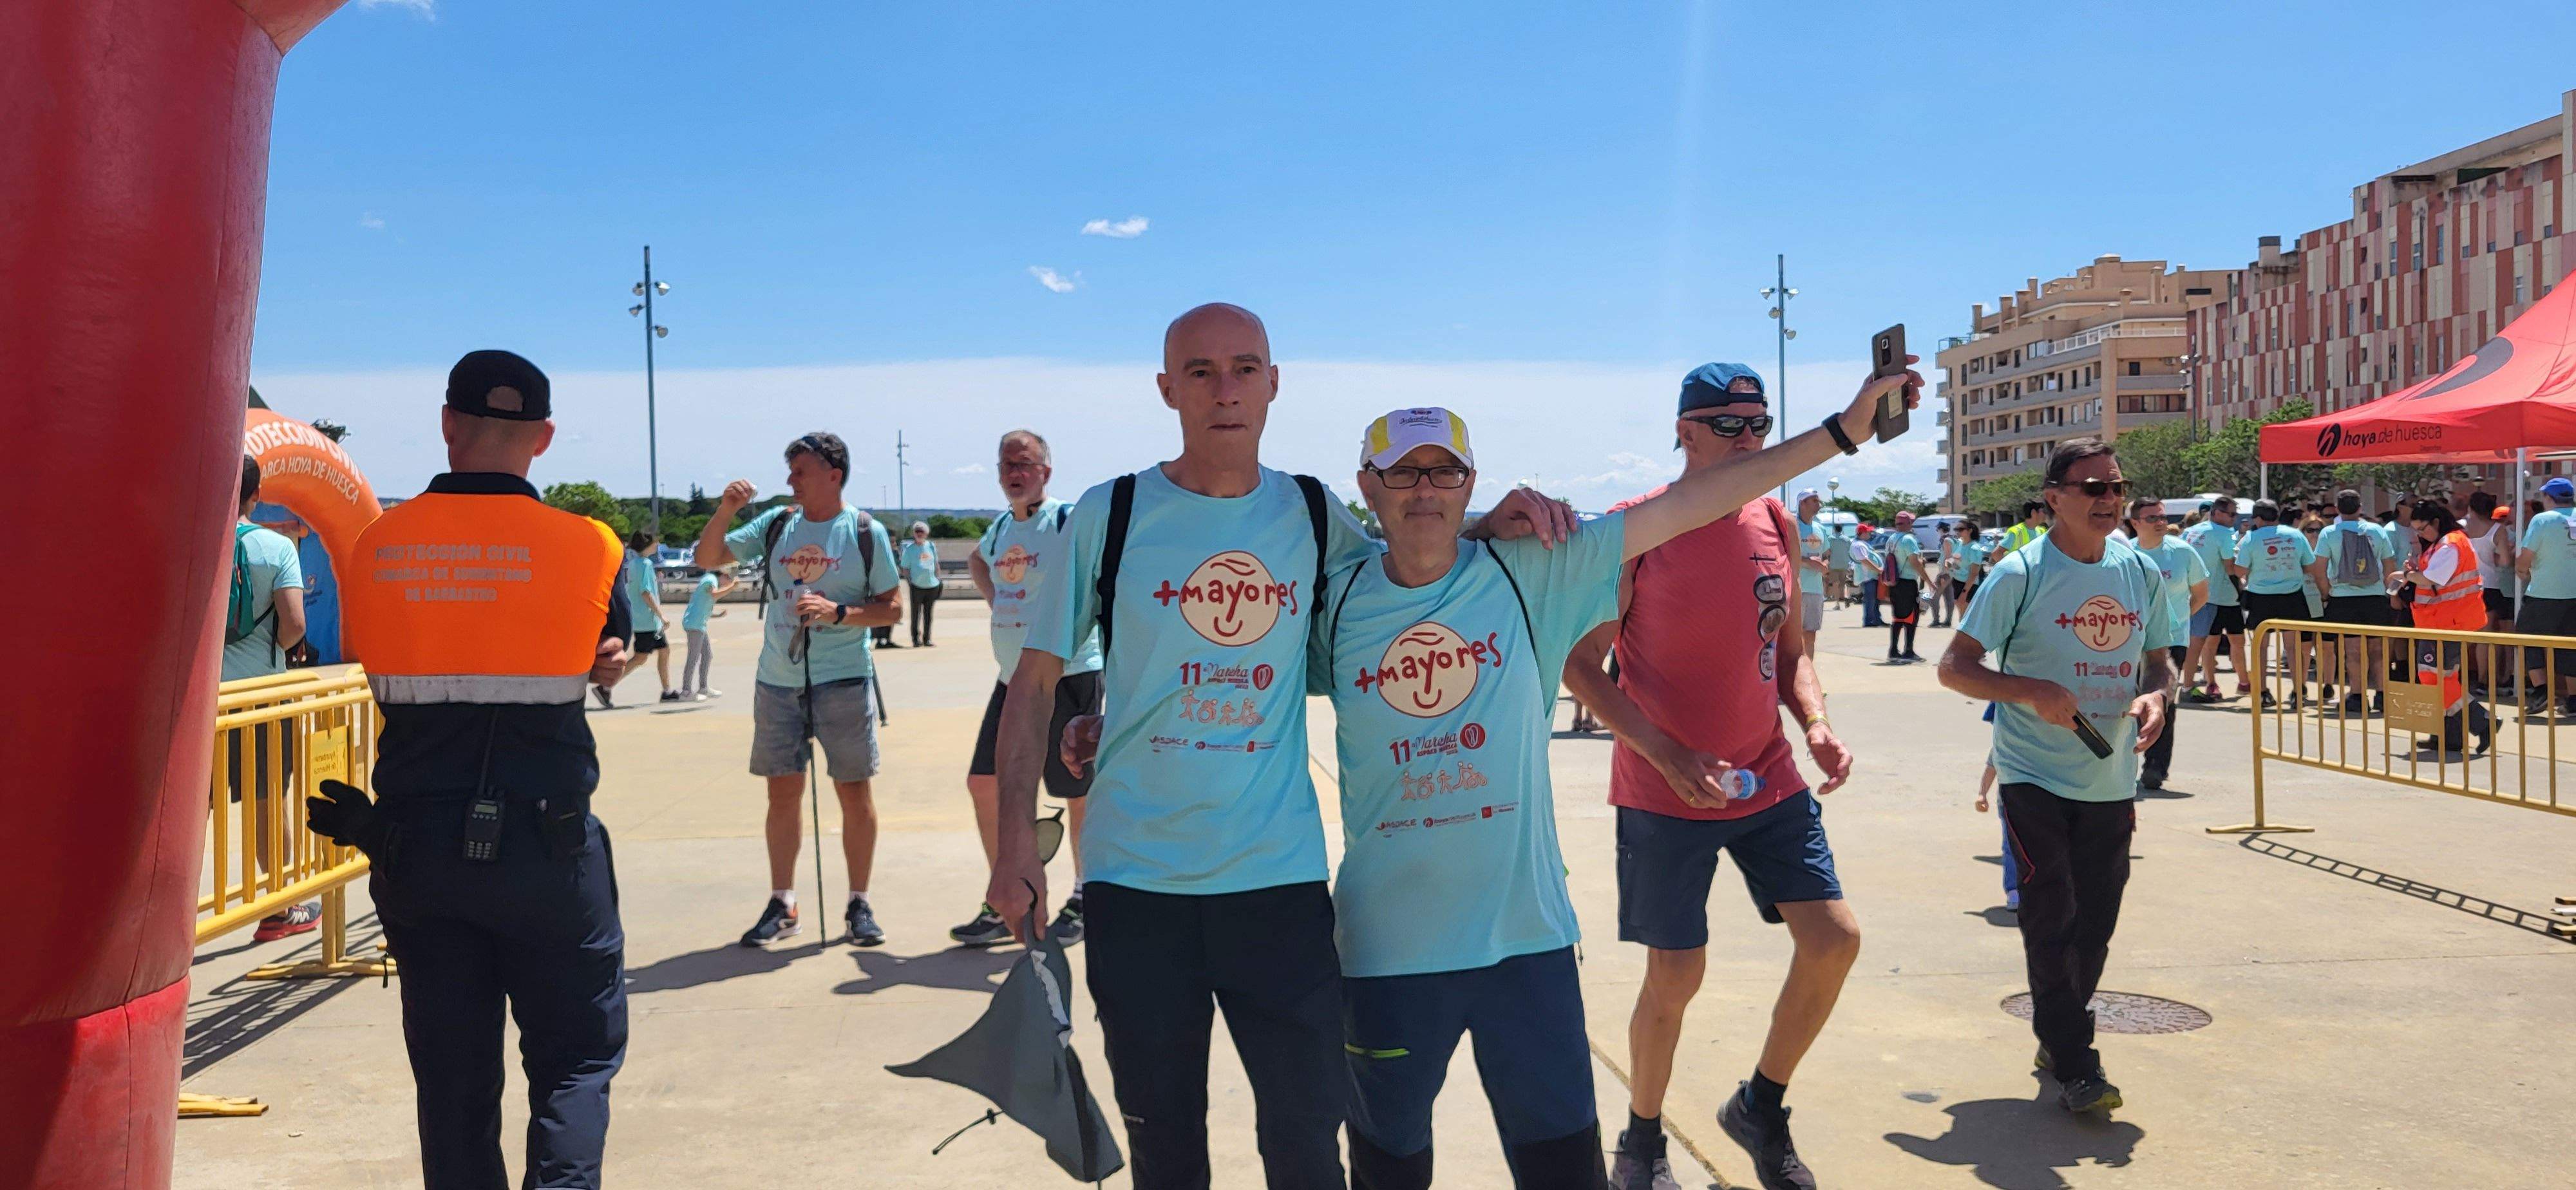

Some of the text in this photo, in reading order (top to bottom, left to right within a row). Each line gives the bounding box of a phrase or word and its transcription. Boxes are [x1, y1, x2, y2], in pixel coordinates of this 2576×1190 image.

[262, 455, 359, 505] ARCA HOYA DE HUESCA
[486, 545, 532, 563] CIVIL
